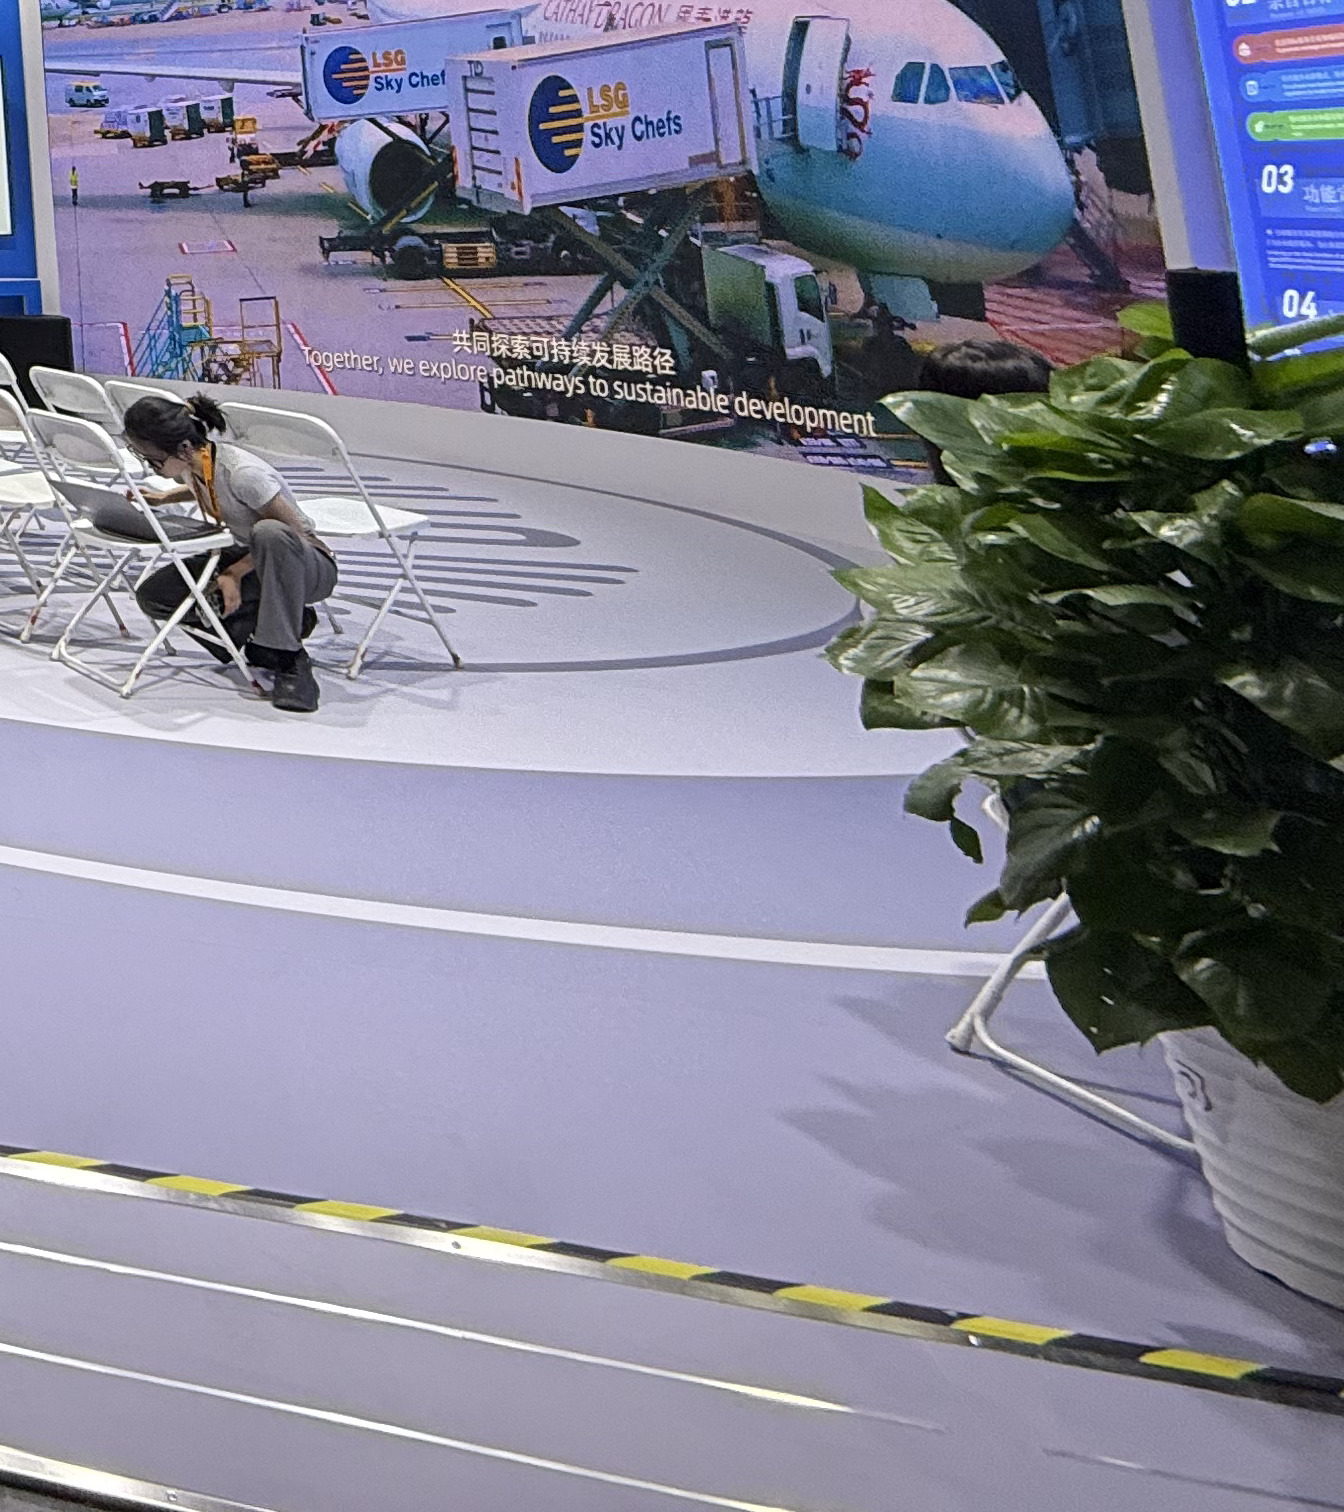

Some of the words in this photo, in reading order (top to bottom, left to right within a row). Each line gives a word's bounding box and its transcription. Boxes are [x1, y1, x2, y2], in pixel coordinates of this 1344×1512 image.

[372, 48, 406, 68] LSG
[374, 74, 403, 94] Sky
[587, 81, 629, 114] LSG
[590, 121, 625, 151] Sky
[631, 110, 682, 142] Chefs
[1261, 164, 1294, 194] 03
[1283, 289, 1317, 319] 04
[452, 329, 676, 376] 共同探索可持续发展路径
[303, 345, 383, 376] Together,
[388, 358, 414, 375] we
[419, 358, 487, 390] explore
[493, 365, 586, 402] pathways
[589, 375, 609, 399] to
[612, 378, 730, 416] sustainable
[733, 393, 879, 437] development
